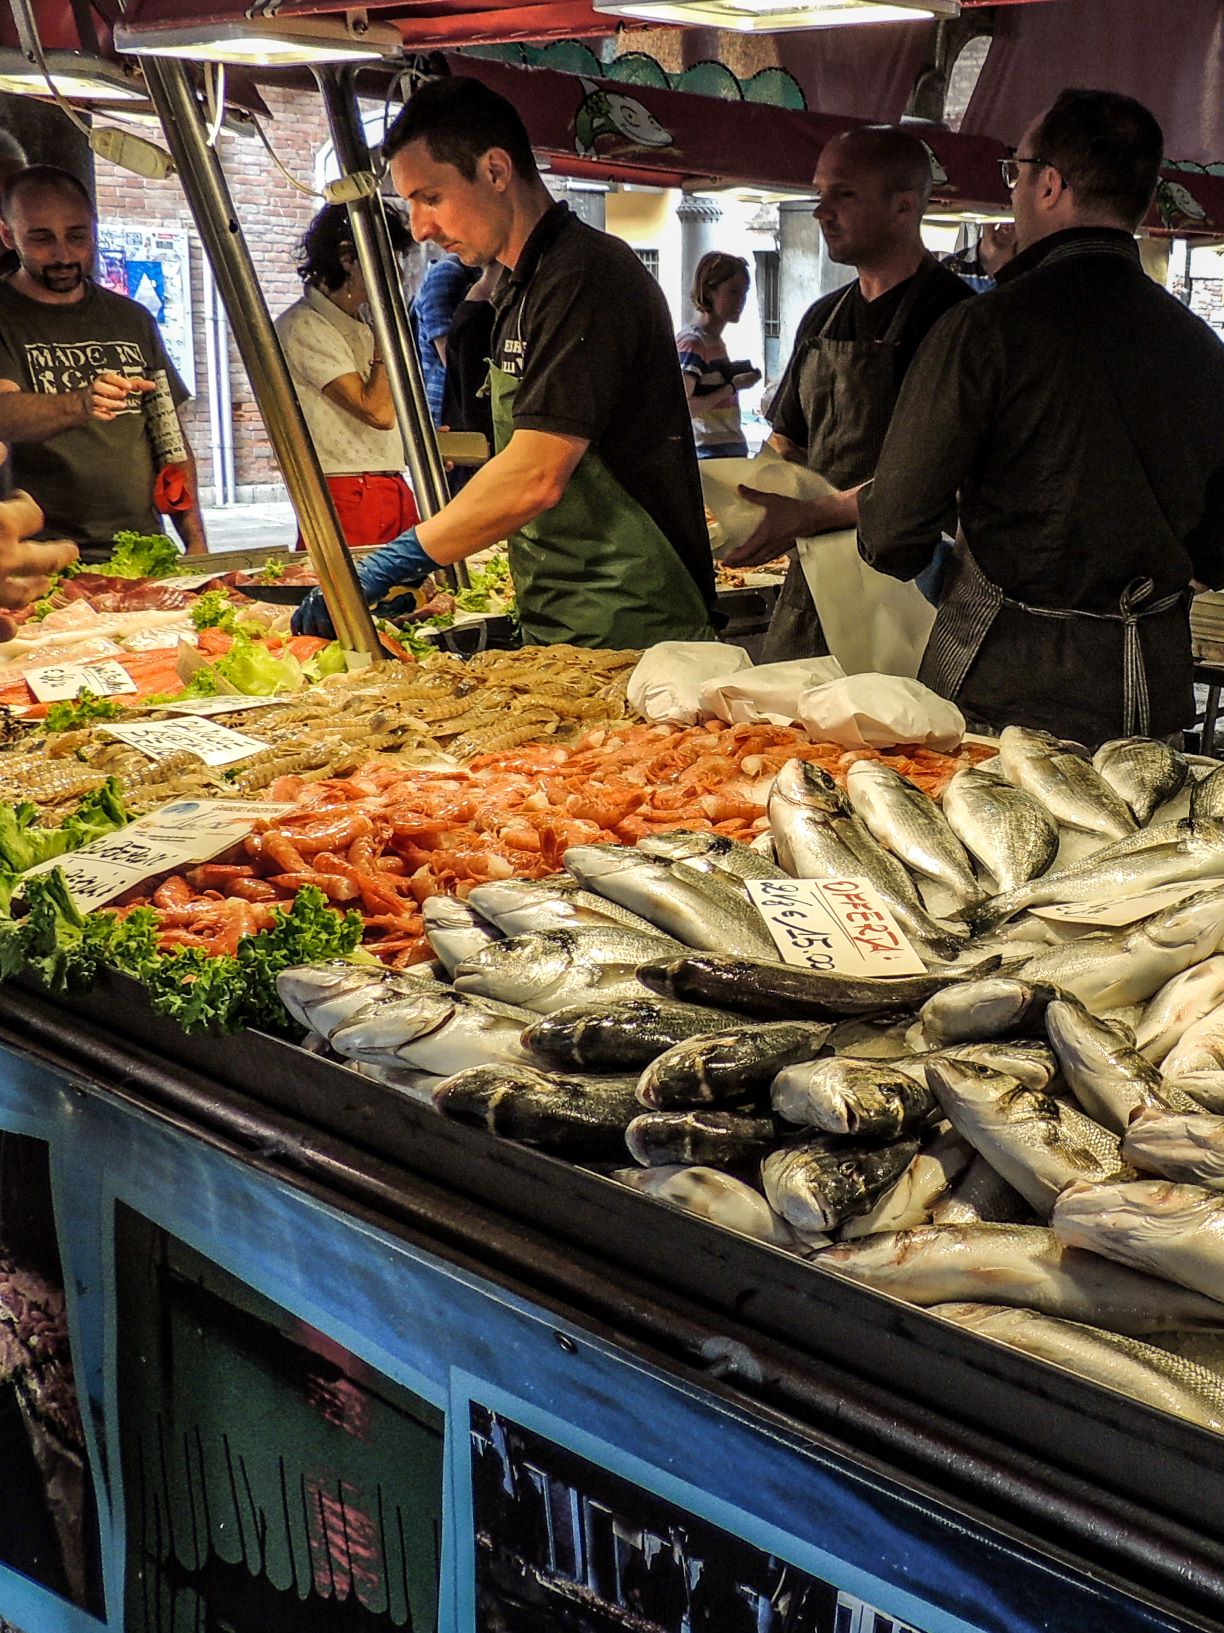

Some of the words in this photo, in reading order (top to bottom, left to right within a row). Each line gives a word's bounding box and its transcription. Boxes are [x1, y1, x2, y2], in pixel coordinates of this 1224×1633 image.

[32, 345, 108, 368] MADE
[115, 345, 142, 363] IN
[771, 916, 836, 971] 15.00
